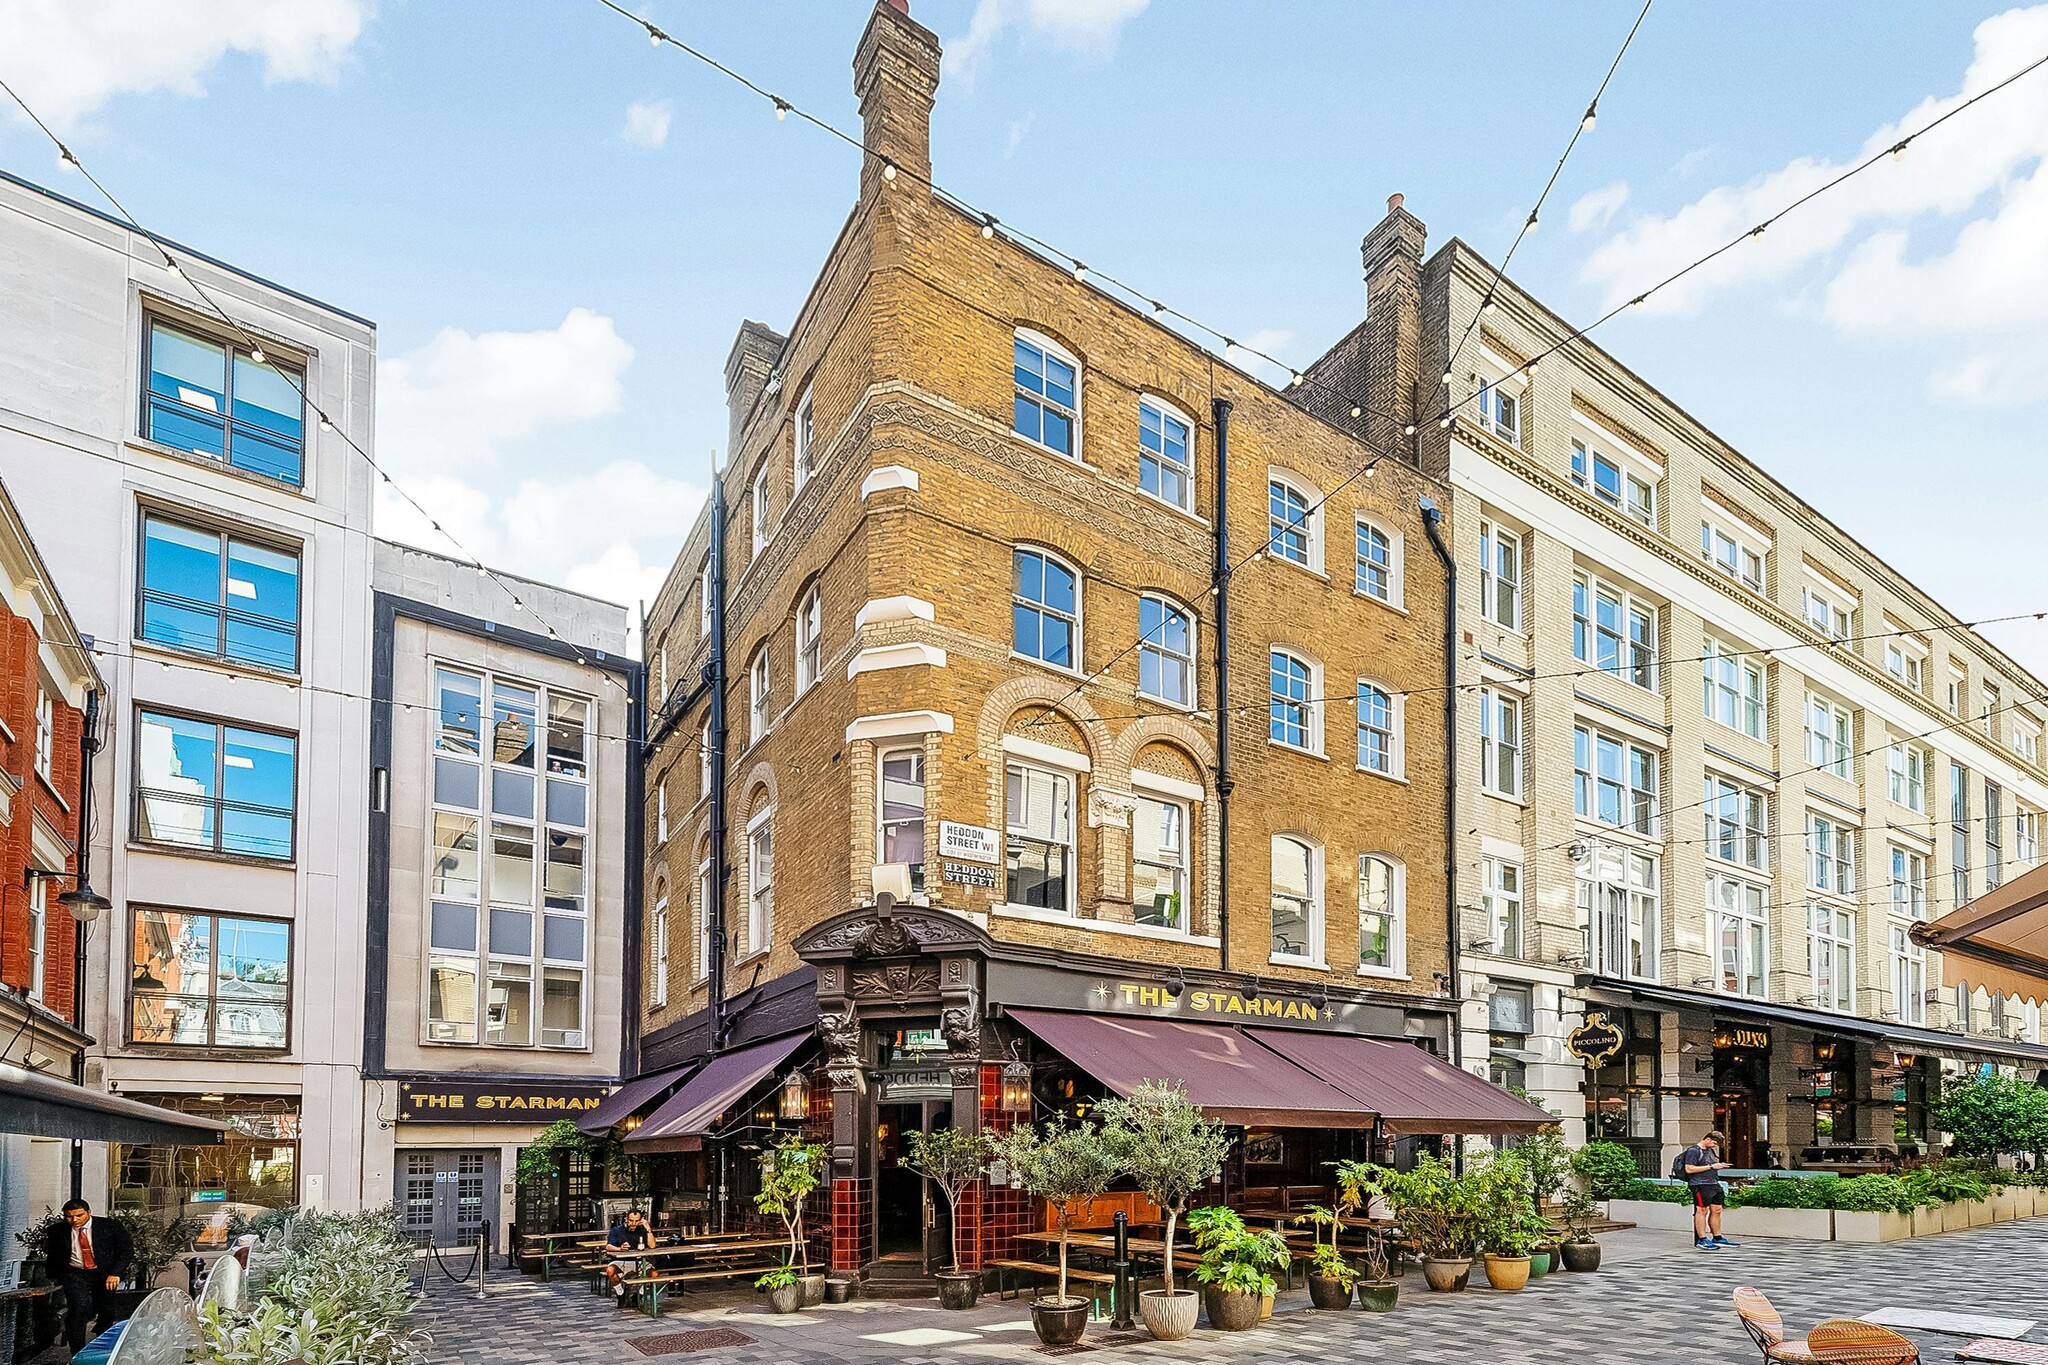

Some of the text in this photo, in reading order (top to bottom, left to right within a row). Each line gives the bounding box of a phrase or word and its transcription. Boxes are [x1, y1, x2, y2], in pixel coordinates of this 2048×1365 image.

[947, 825, 984, 840] HEDDON
[947, 835, 993, 852] STREET W1
[944, 862, 995, 878] HEDDON
[945, 871, 995, 887] STREET
[1119, 984, 1318, 1021] THE STARMAN
[1573, 1036, 1617, 1047] PICCOLINO
[410, 1094, 600, 1110] THE STARMAN
